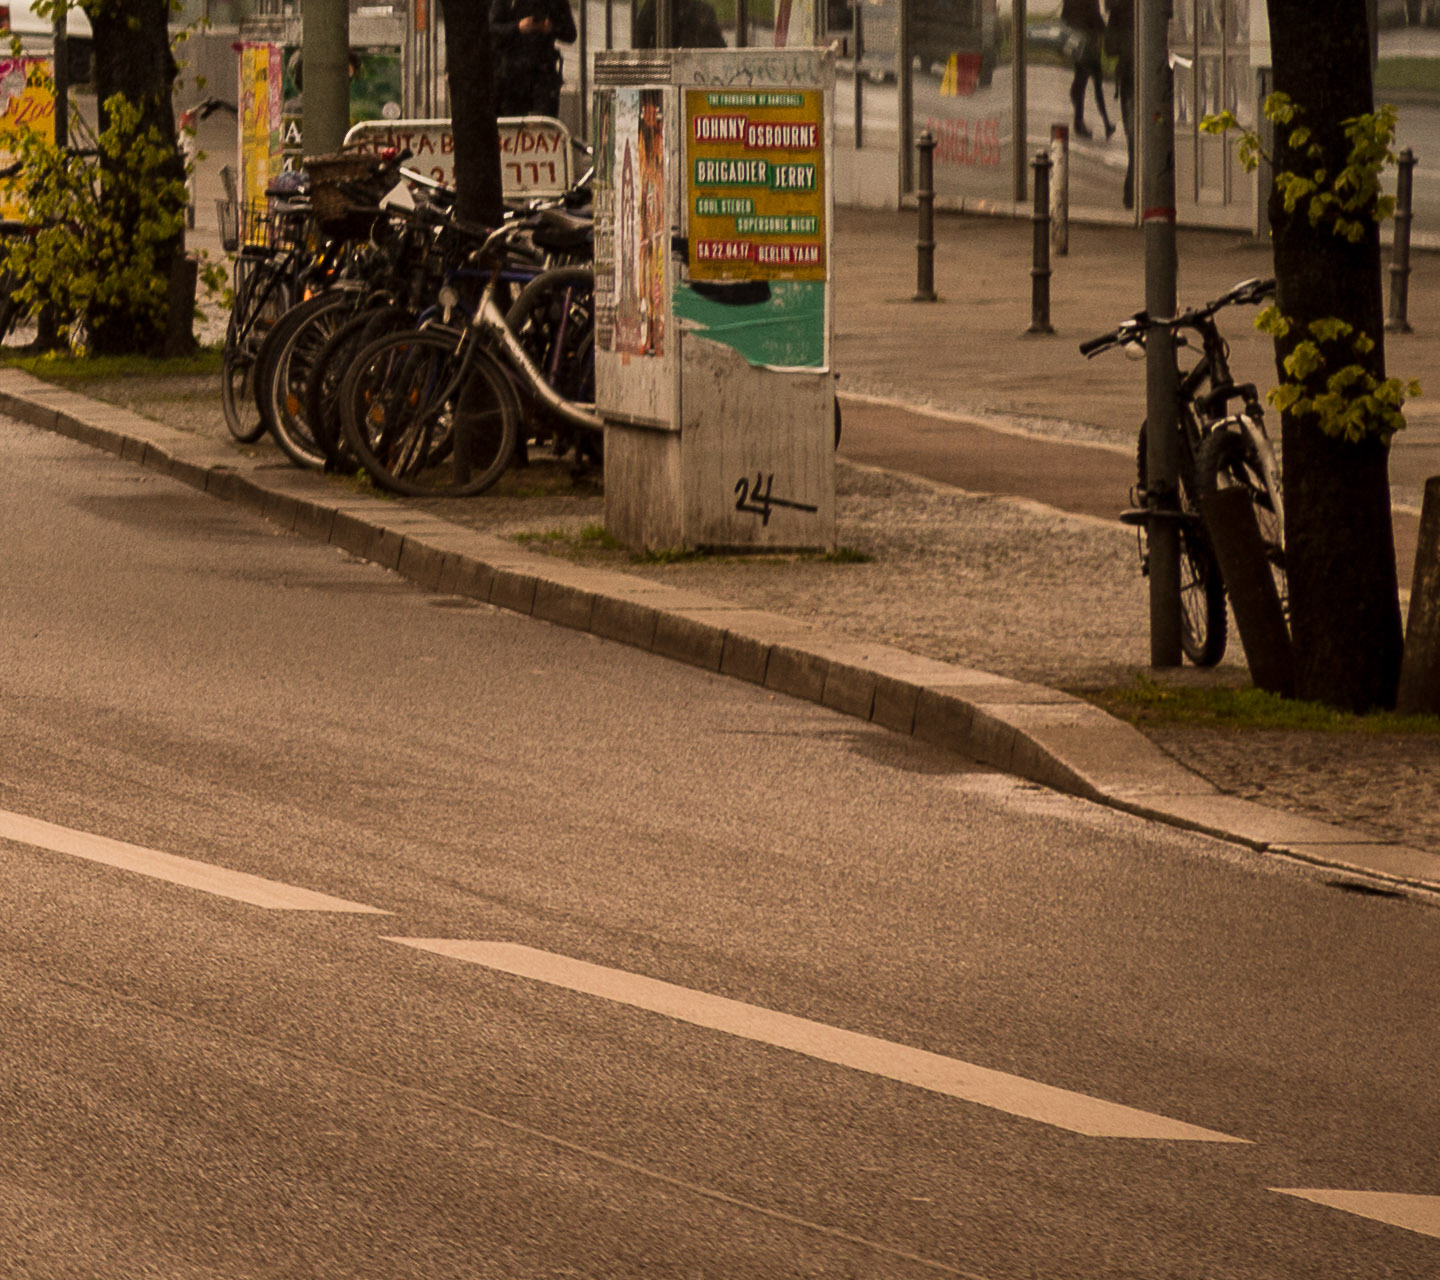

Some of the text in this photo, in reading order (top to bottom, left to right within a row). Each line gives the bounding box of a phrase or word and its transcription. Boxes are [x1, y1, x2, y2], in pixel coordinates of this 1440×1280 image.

[696, 117, 816, 146] JOHNNY OSBOURNE
[698, 161, 814, 188] BRIGADIER JERRY
[737, 218, 789, 232] SUPERSONIC
[758, 246, 791, 262] BERLIN
[792, 246, 818, 262] YAAM
